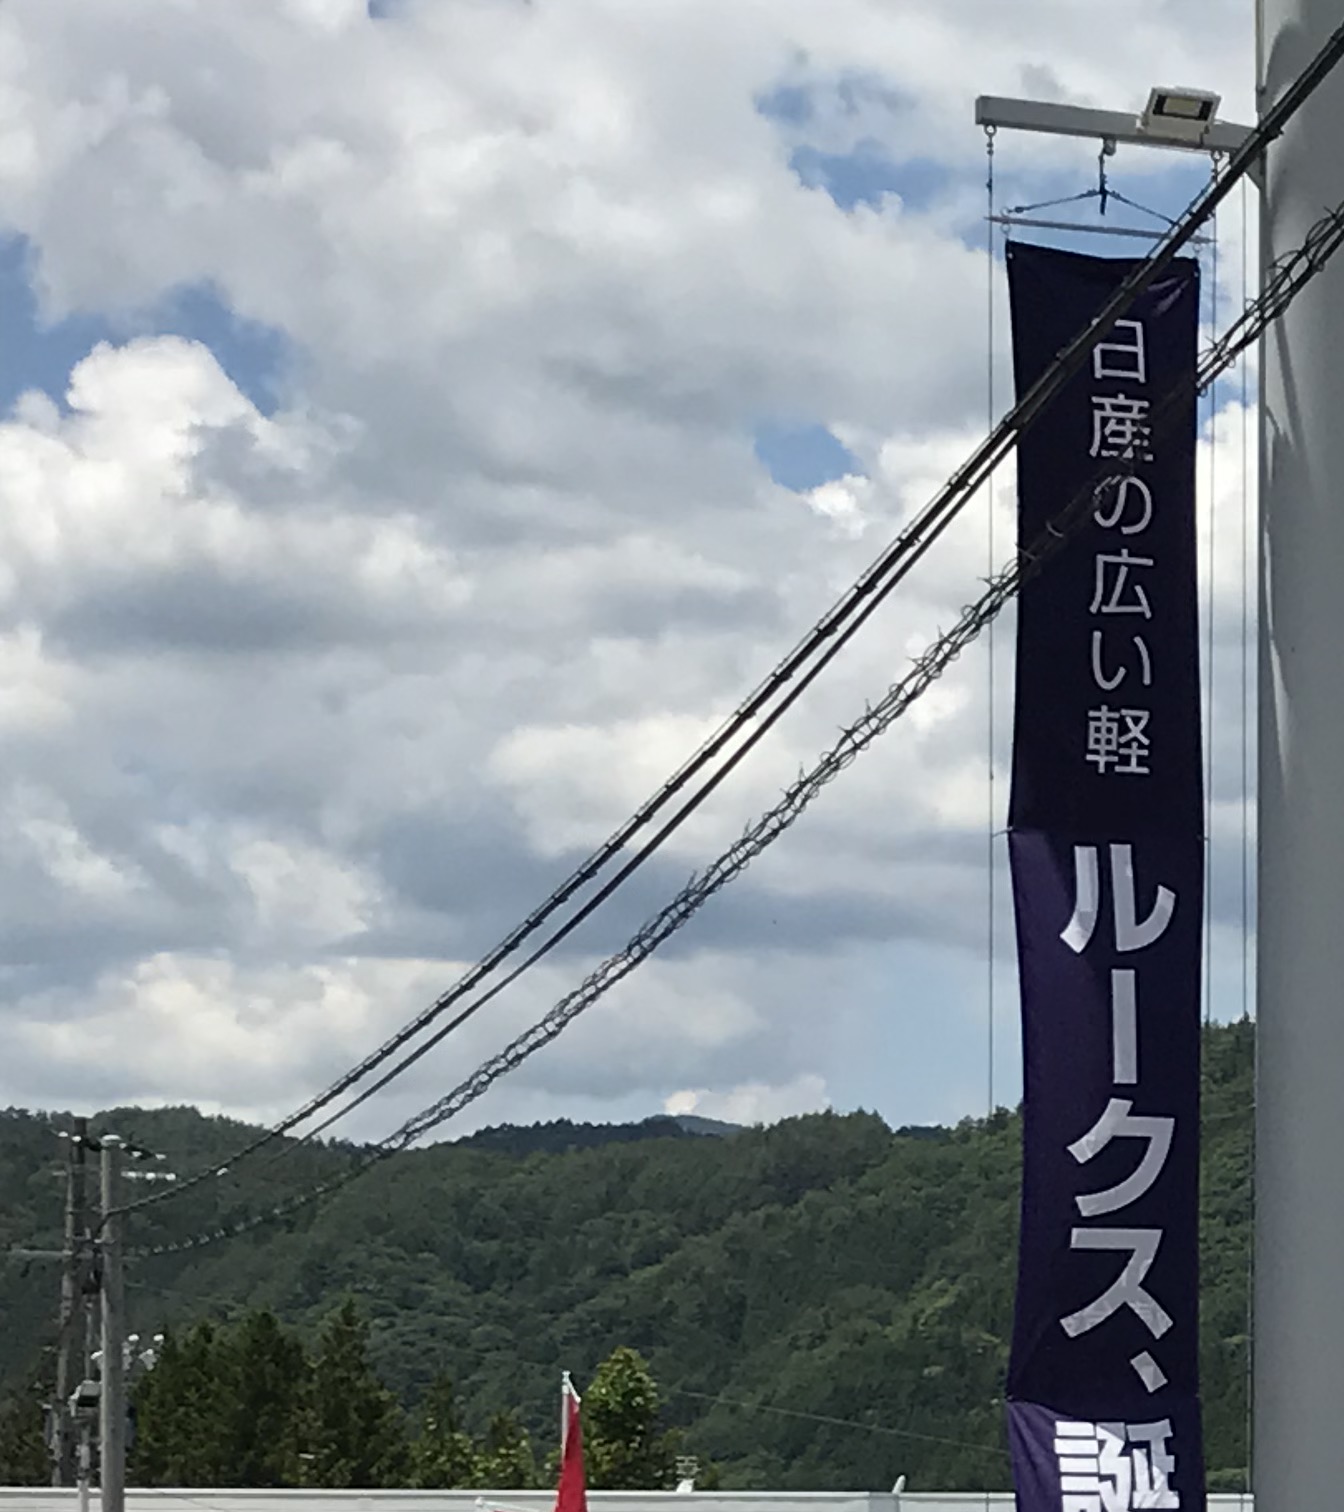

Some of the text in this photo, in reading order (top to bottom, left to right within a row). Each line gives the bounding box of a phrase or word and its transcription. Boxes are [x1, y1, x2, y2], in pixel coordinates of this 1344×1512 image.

[1086, 317, 1154, 775] 日産の広い軽
